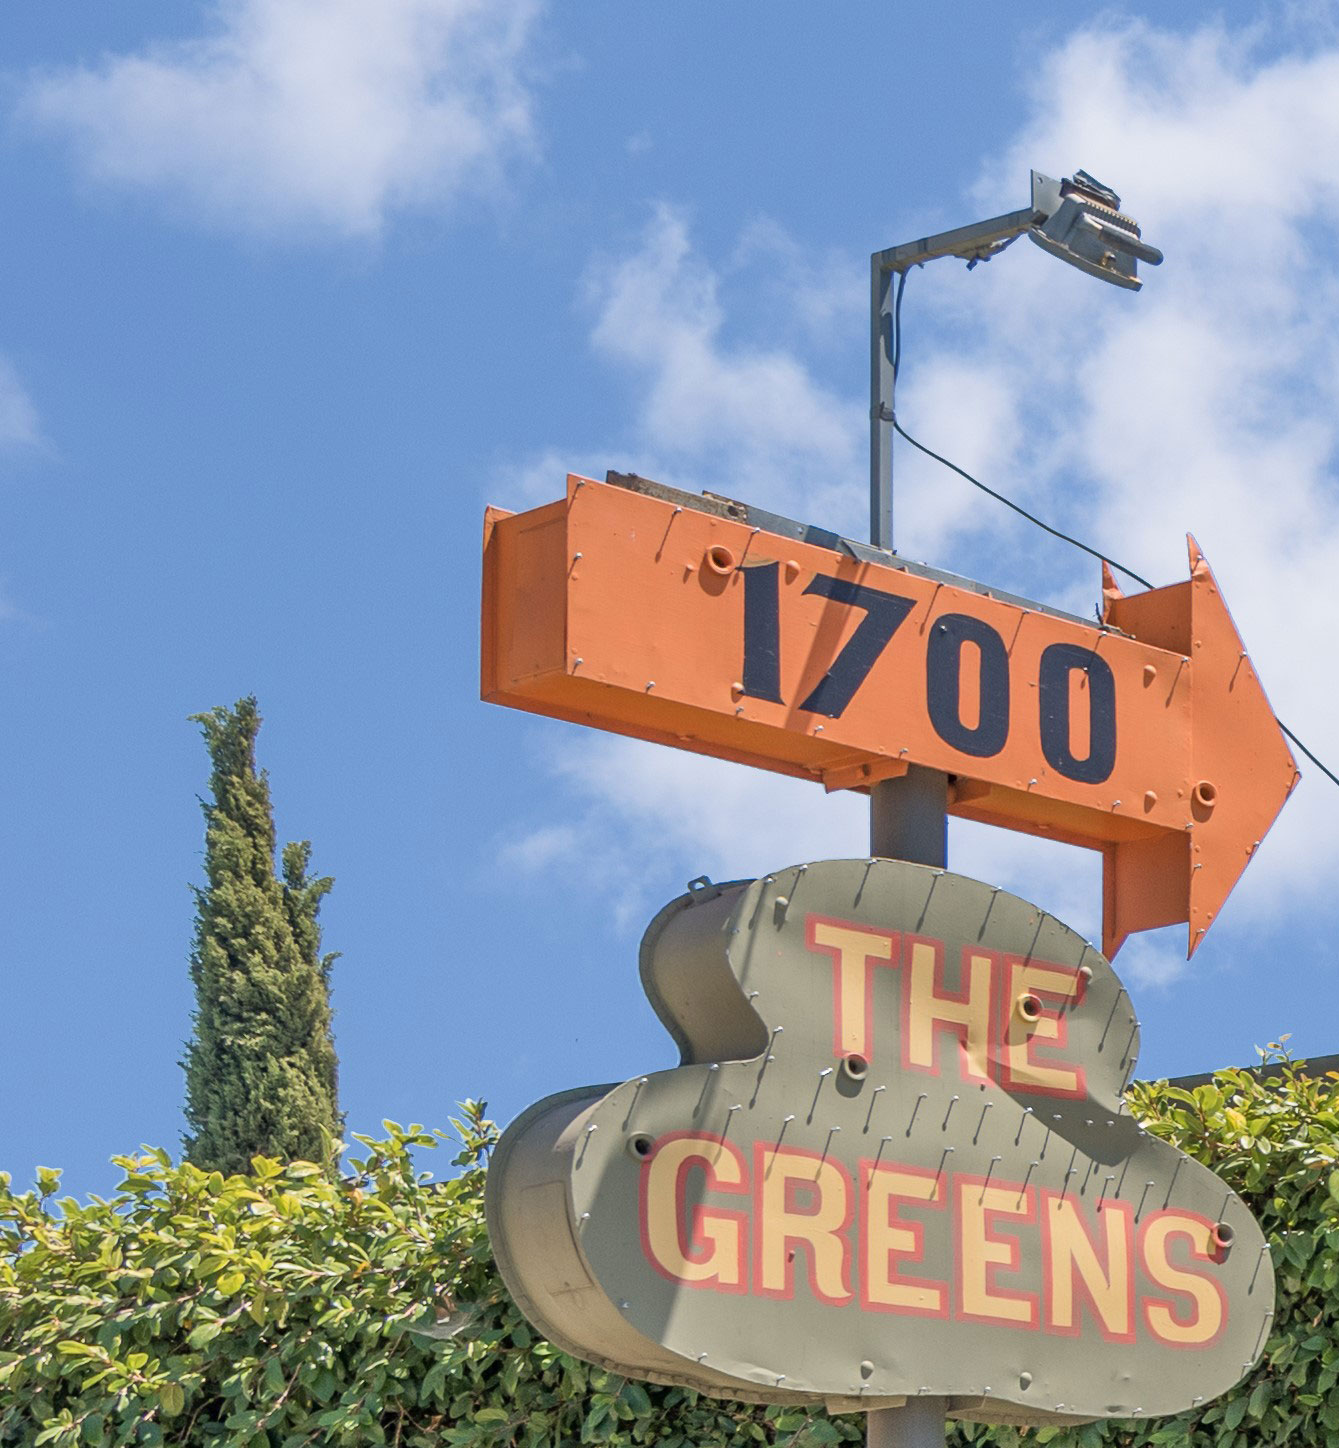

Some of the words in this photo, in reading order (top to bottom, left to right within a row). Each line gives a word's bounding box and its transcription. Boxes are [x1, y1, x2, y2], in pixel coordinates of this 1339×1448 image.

[735, 559, 1117, 784] 1700
[805, 916, 1091, 1100] THE
[640, 1131, 1230, 1348] GREENS
